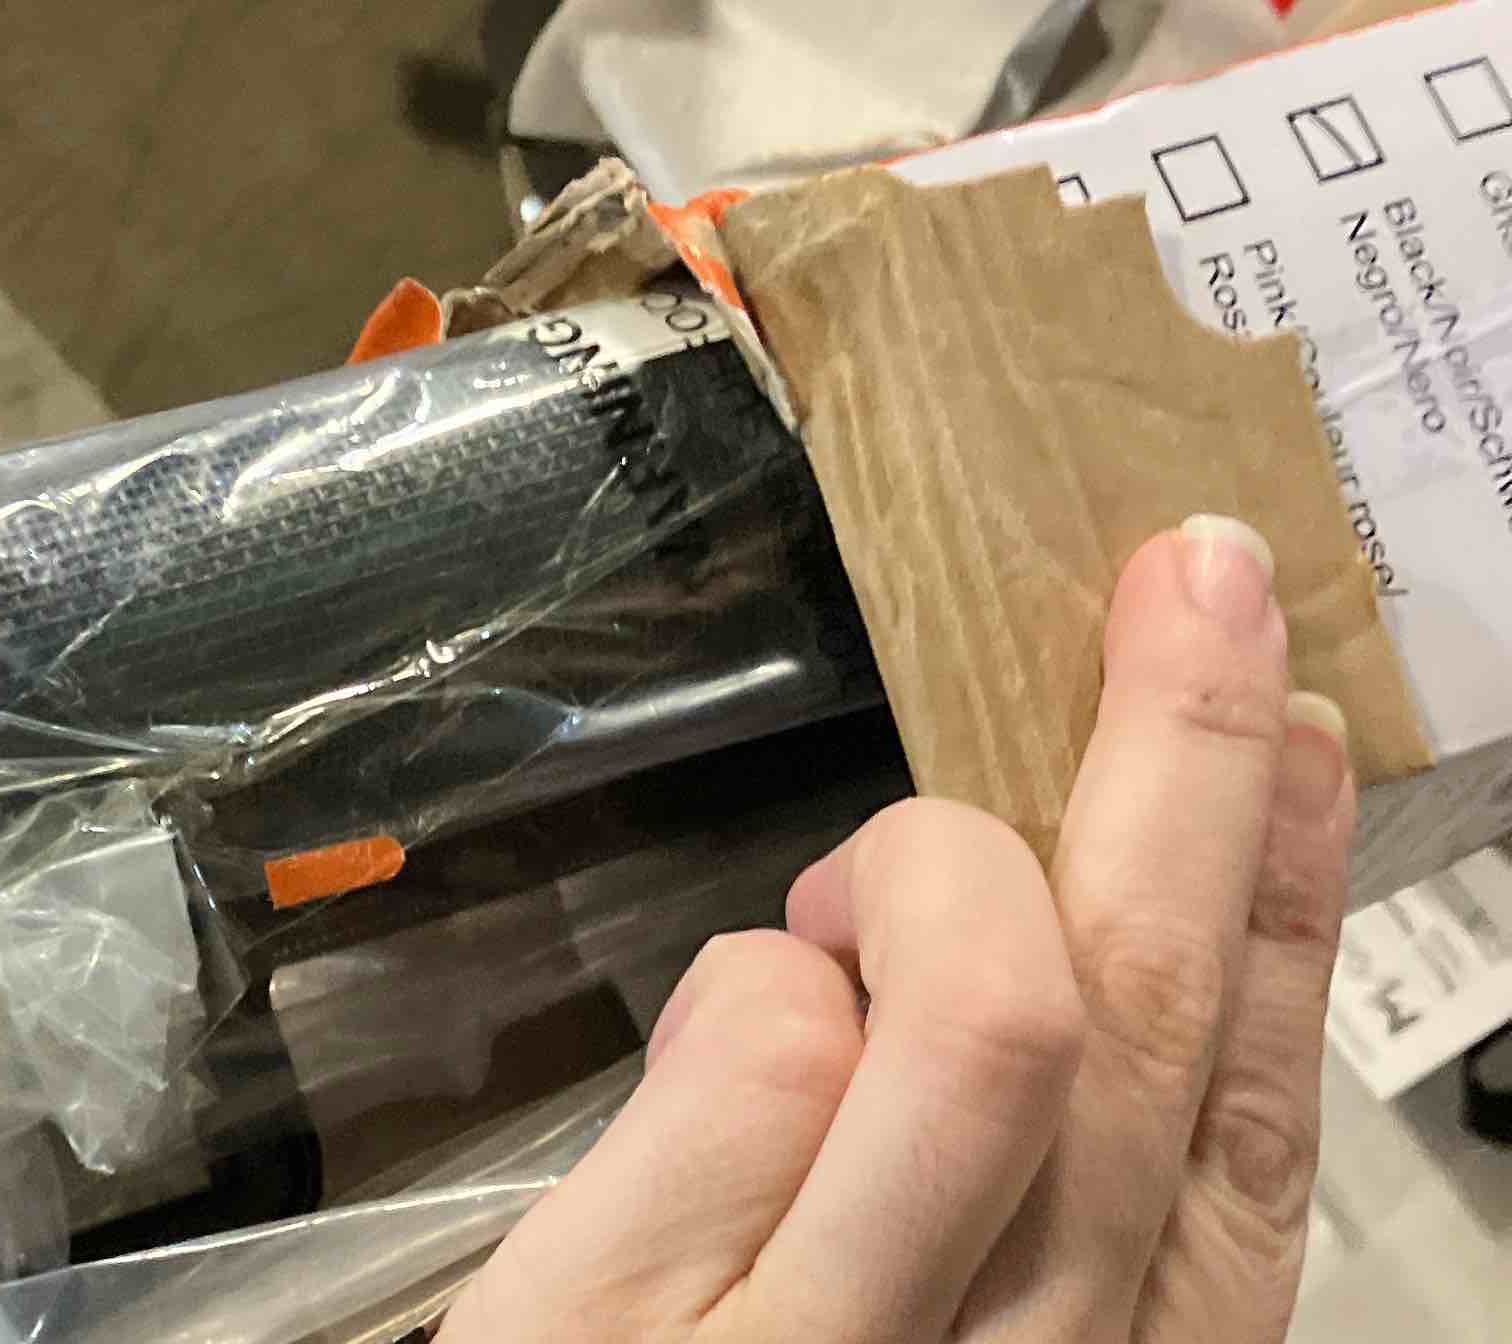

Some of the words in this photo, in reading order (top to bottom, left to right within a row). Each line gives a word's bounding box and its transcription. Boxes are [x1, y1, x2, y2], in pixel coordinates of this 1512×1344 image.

[1198, 252, 1252, 337] Ros
[1339, 210, 1446, 434] Negro/Nero
[1383, 196, 1512, 533] Black/Noir/Sch
